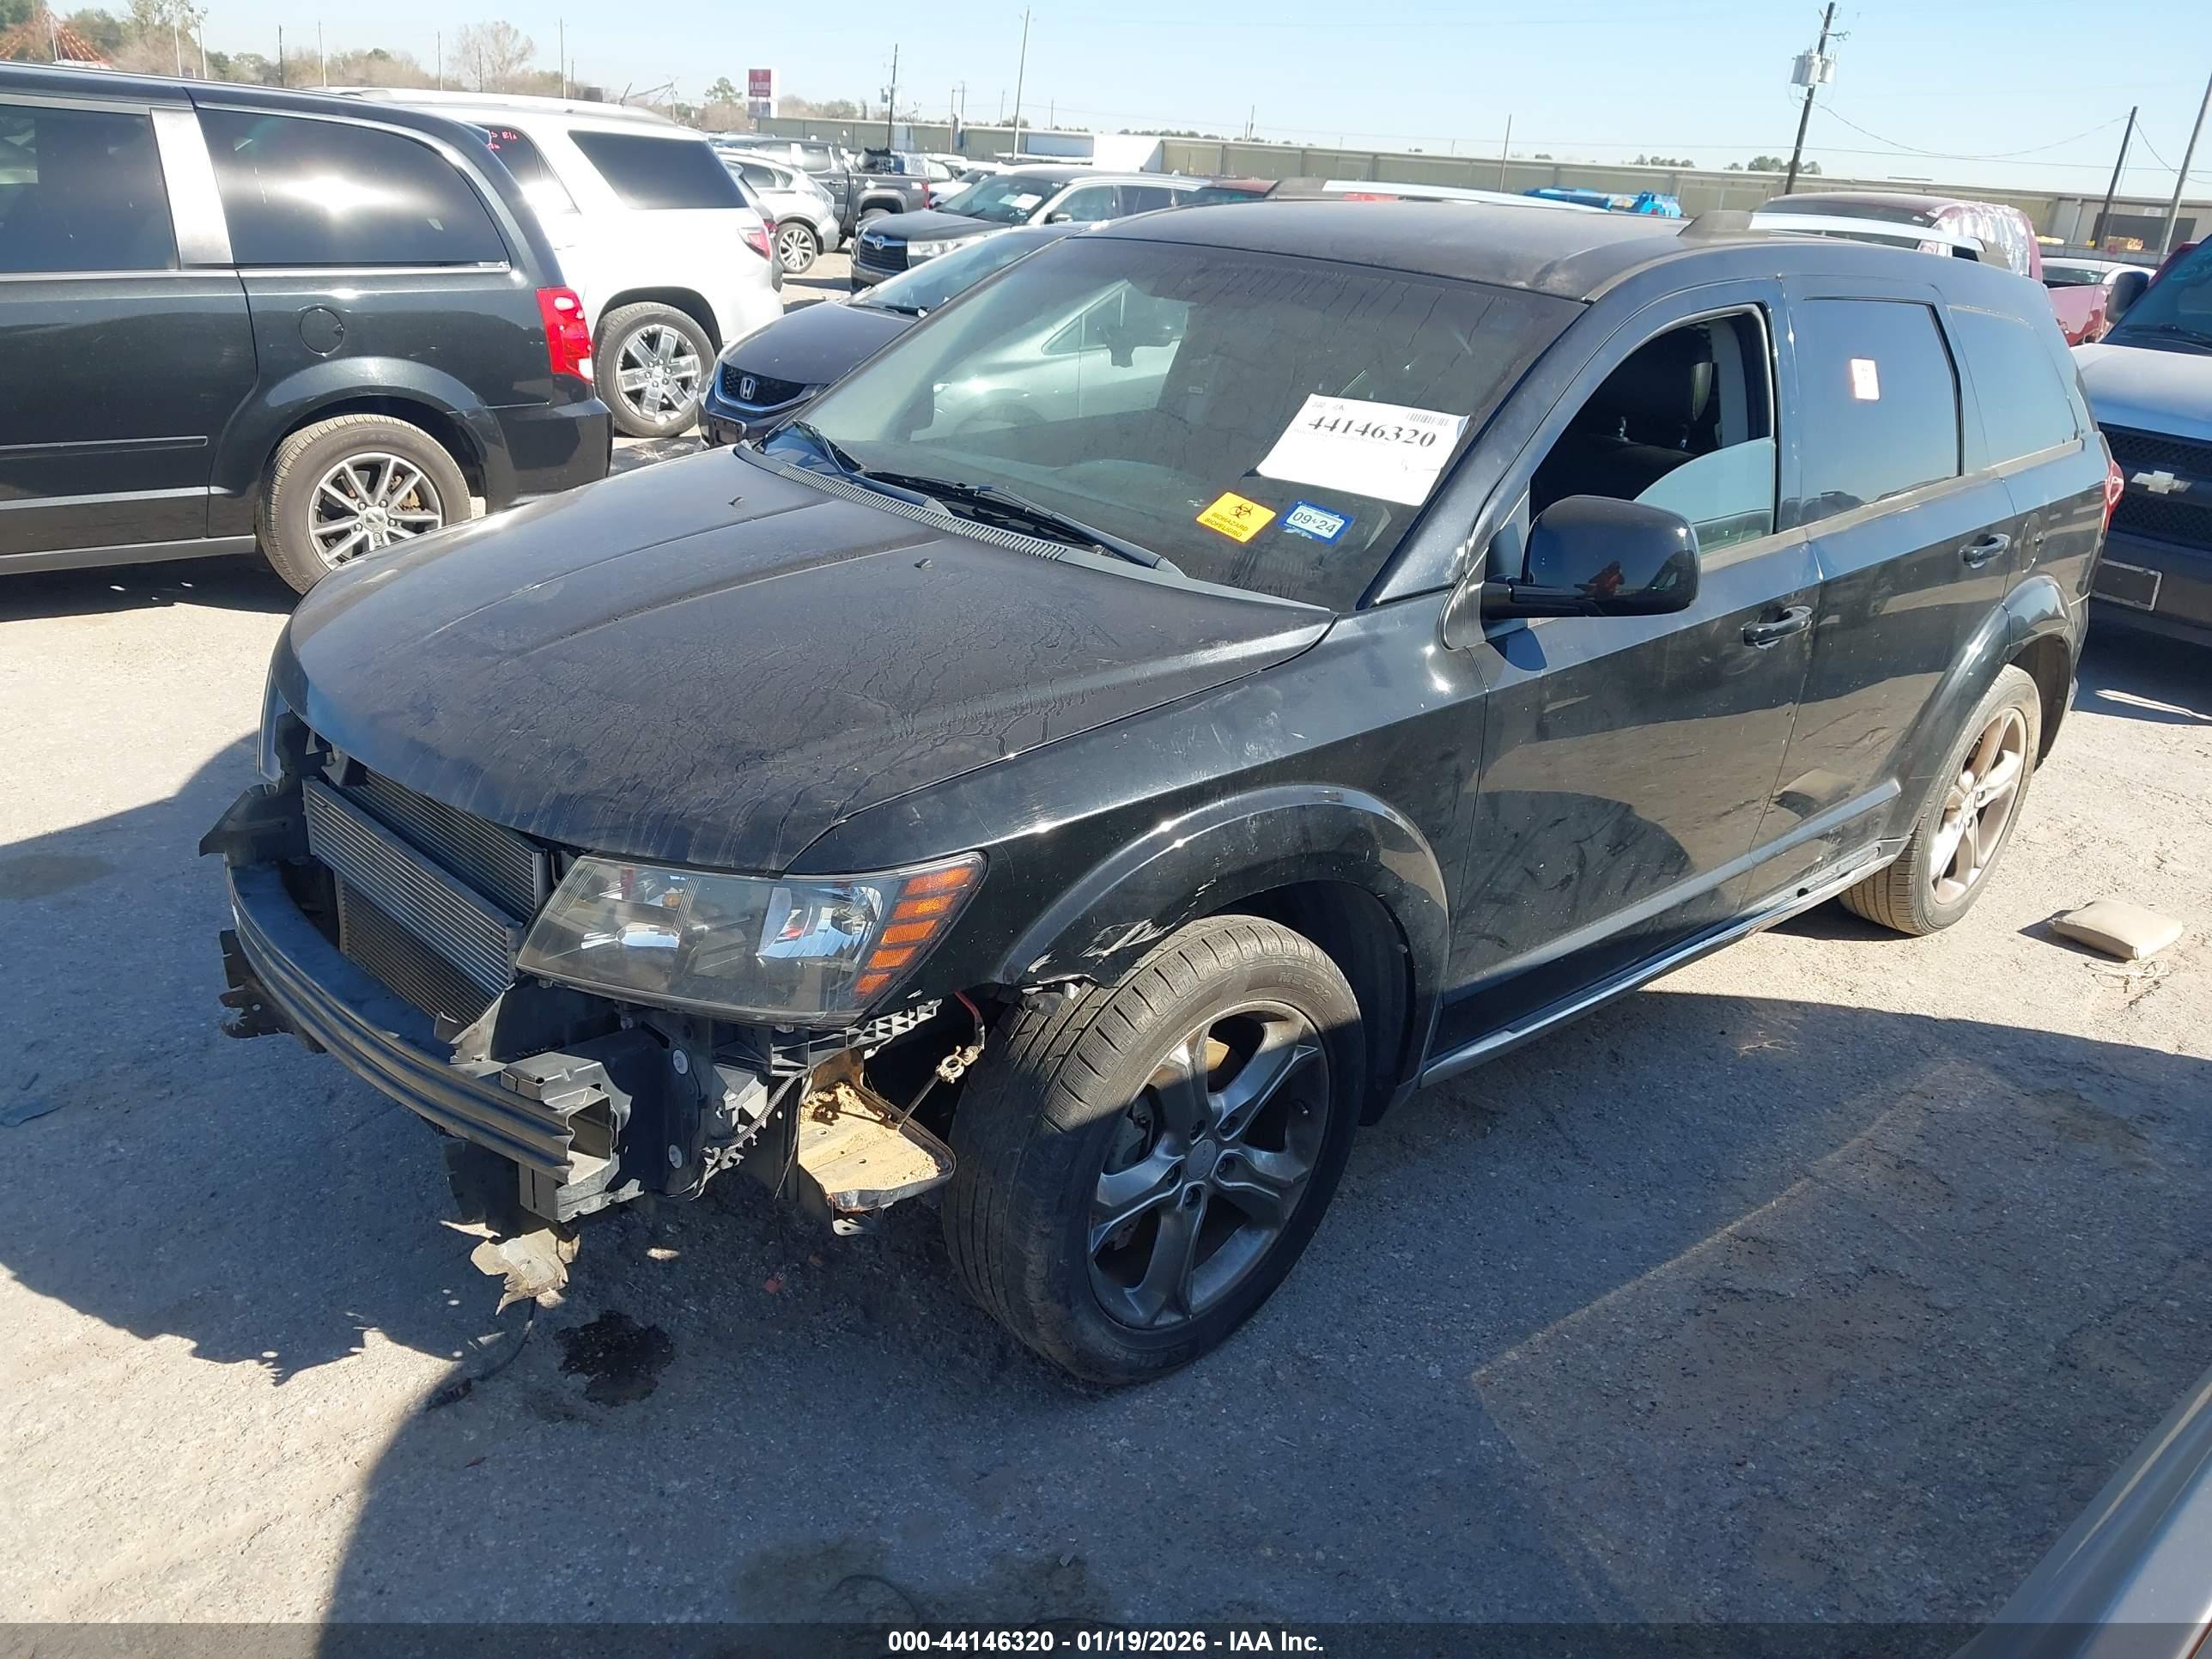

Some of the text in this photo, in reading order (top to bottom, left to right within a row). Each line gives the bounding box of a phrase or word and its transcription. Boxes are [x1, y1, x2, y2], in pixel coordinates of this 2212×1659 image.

[1307, 416, 1437, 447] 44146320
[1204, 517, 1243, 538] BIOPELIGRO
[1211, 512, 1249, 532] BIOHAZARD
